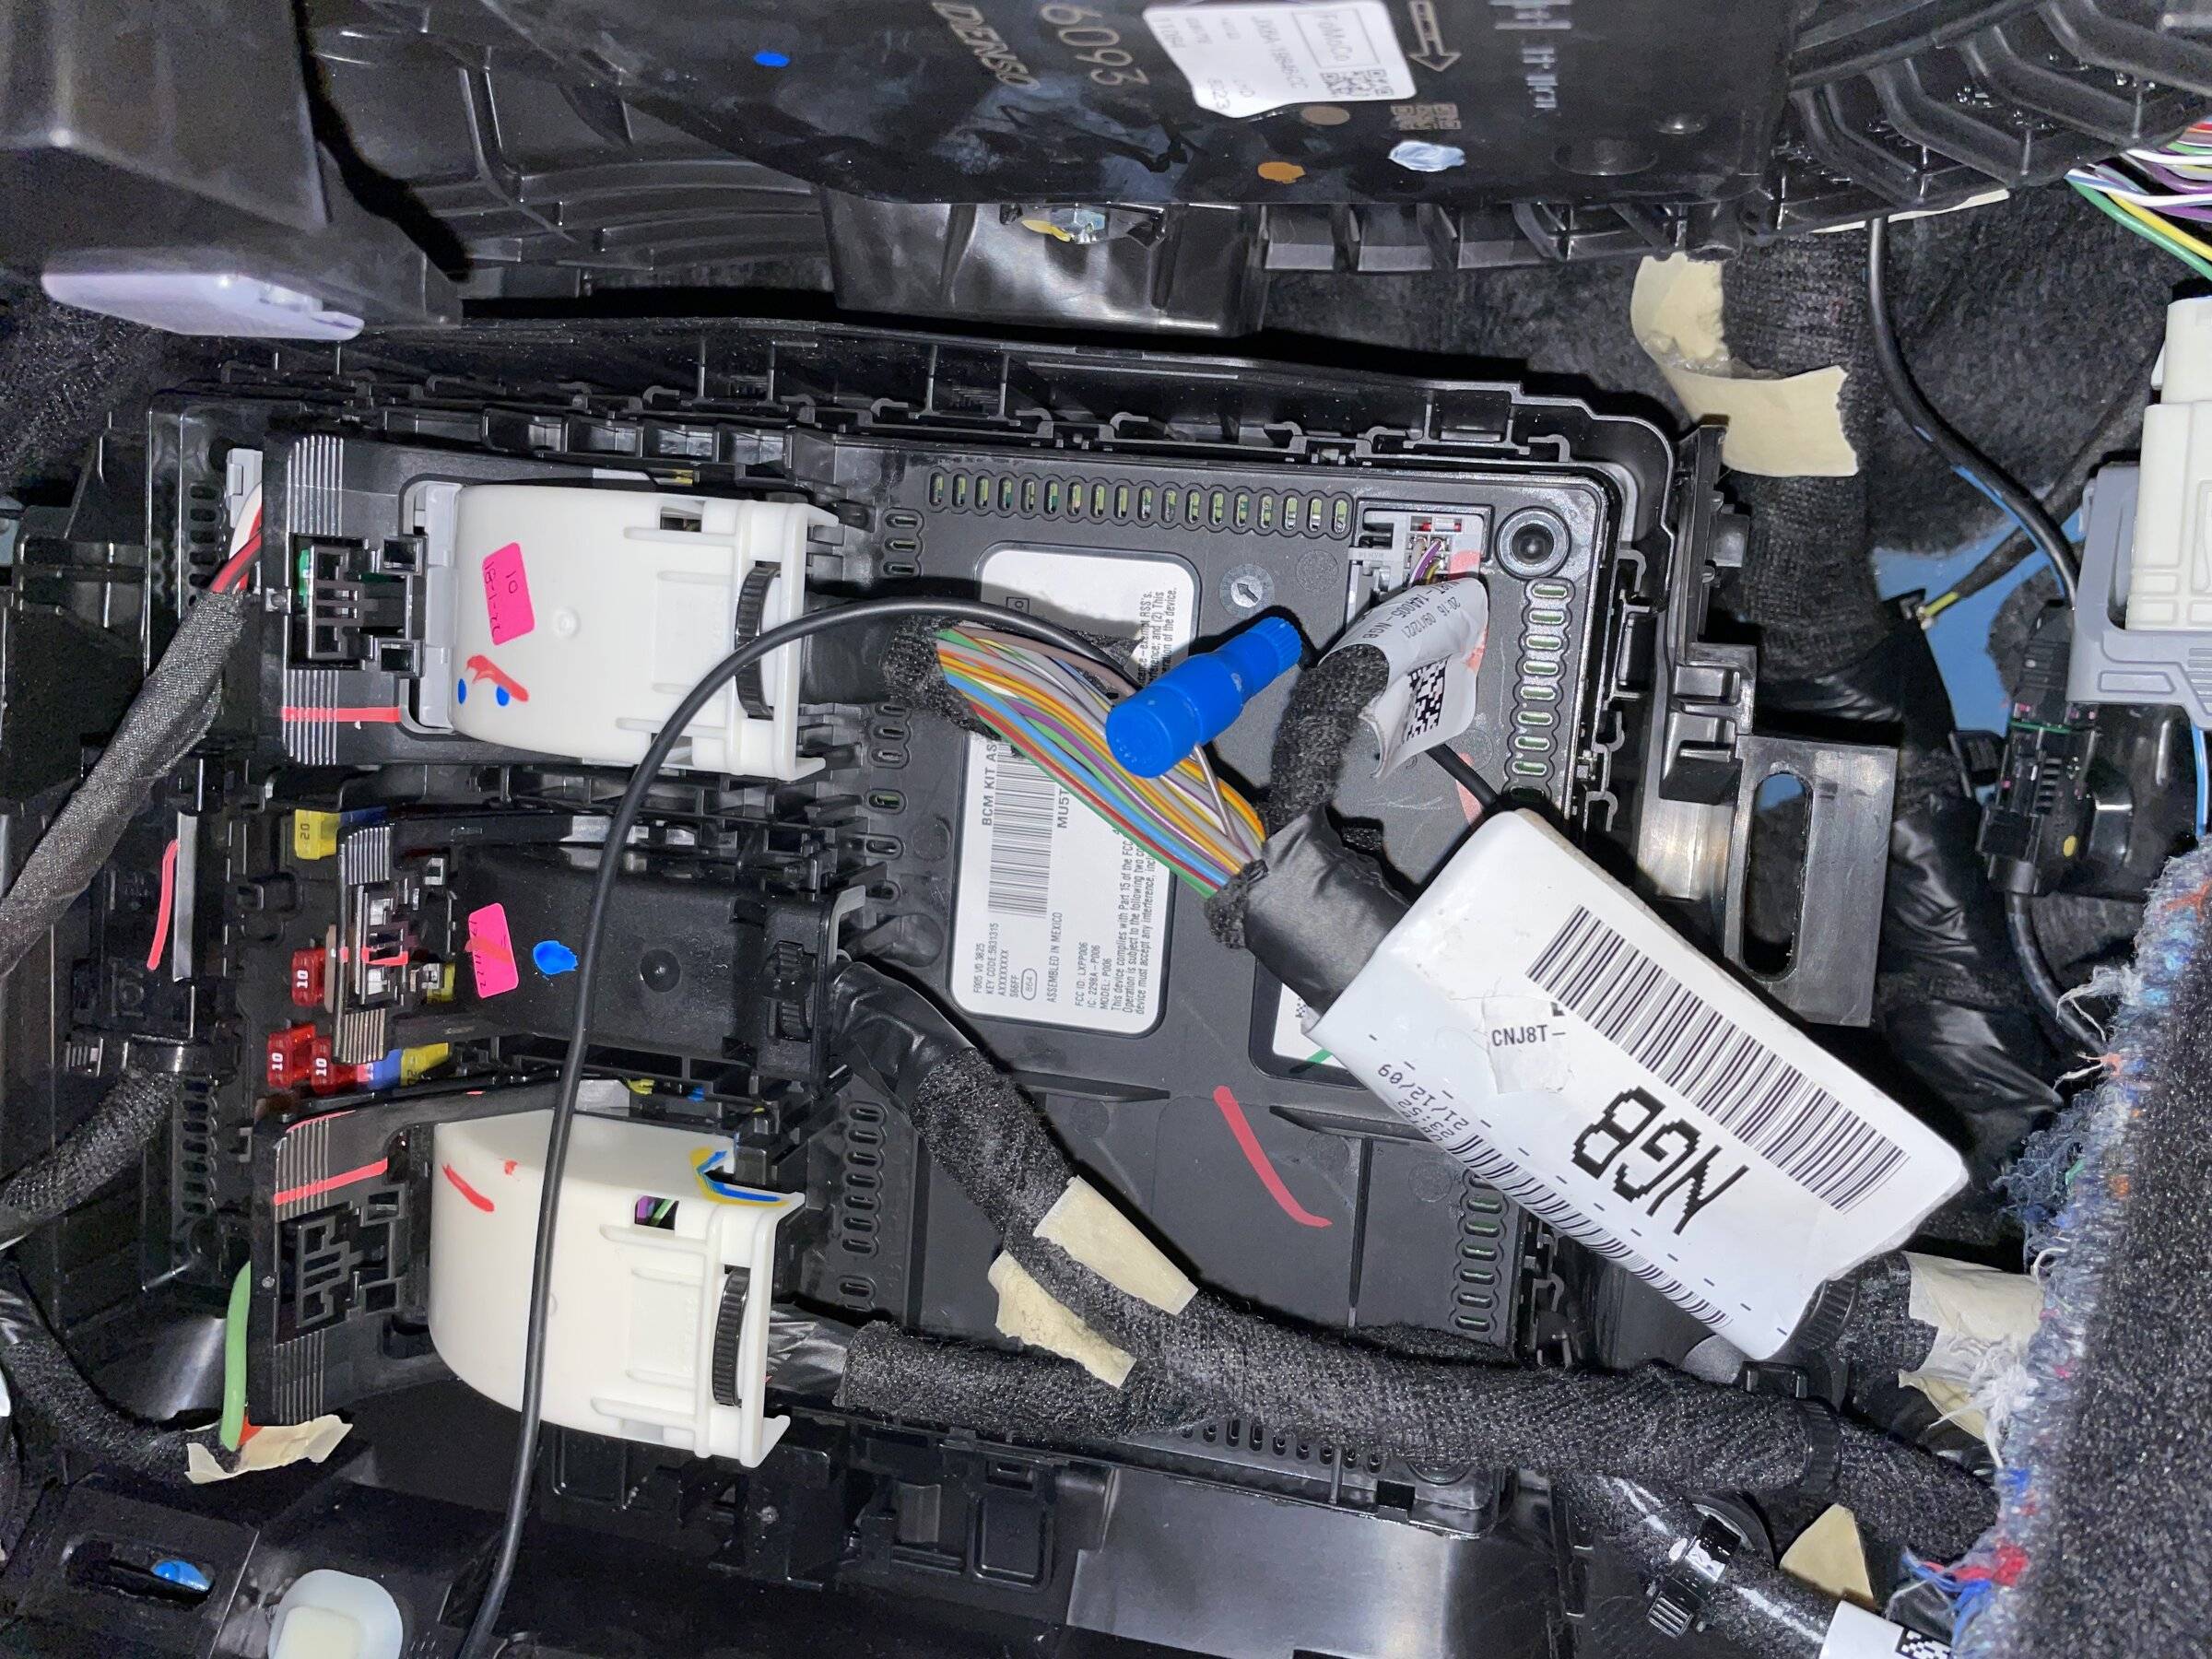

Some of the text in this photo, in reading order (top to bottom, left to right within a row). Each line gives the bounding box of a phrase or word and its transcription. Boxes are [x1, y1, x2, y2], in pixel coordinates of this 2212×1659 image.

[933, 2, 1041, 89] DENSO
[1041, 6, 1149, 86] 6093
[1314, 13, 1353, 62] FoMoCo
[504, 570, 518, 594] 10
[1152, 592, 1164, 608] This
[1165, 587, 1177, 617] device.
[1152, 611, 1165, 622] (2)
[1164, 619, 1174, 631] the
[1151, 626, 1163, 641] and
[1163, 634, 1172, 642] of
[984, 767, 995, 790] KIT
[982, 795, 994, 826] BCM
[300, 822, 310, 841] 20
[1122, 841, 1134, 856] FCC
[1122, 859, 1133, 871] the
[1134, 859, 1144, 873] two
[1120, 882, 1131, 891] 15
[1130, 876, 1145, 911] following
[1118, 895, 1130, 911] Part
[1142, 875, 1156, 923] interference,
[1117, 912, 1128, 929] with
[1129, 913, 1140, 925] the
[1129, 927, 1139, 935] to
[1141, 925, 1154, 939] any
[1047, 912, 1063, 1003] ASSEMBLED IN MEXICO
[1115, 931, 1129, 966] complies
[1127, 937, 1142, 965] subject
[1139, 941, 1152, 966] accept
[296, 969, 309, 989] 10
[985, 979, 995, 995] KEY
[1112, 969, 1124, 994] device
[1136, 969, 1147, 988] must
[1075, 992, 1085, 1006] FCC
[1100, 980, 1111, 1010] MODEL:
[1111, 995, 1123, 1011] This
[1122, 976, 1135, 1013] Operation
[1135, 990, 1147, 1015] device
[271, 1052, 284, 1071] 10
[315, 1056, 328, 1077] 10
[1378, 1064, 1469, 1131] 21/12/09
[1398, 1099, 1455, 1138] 23:52
[1571, 1086, 1750, 1236] NGB
